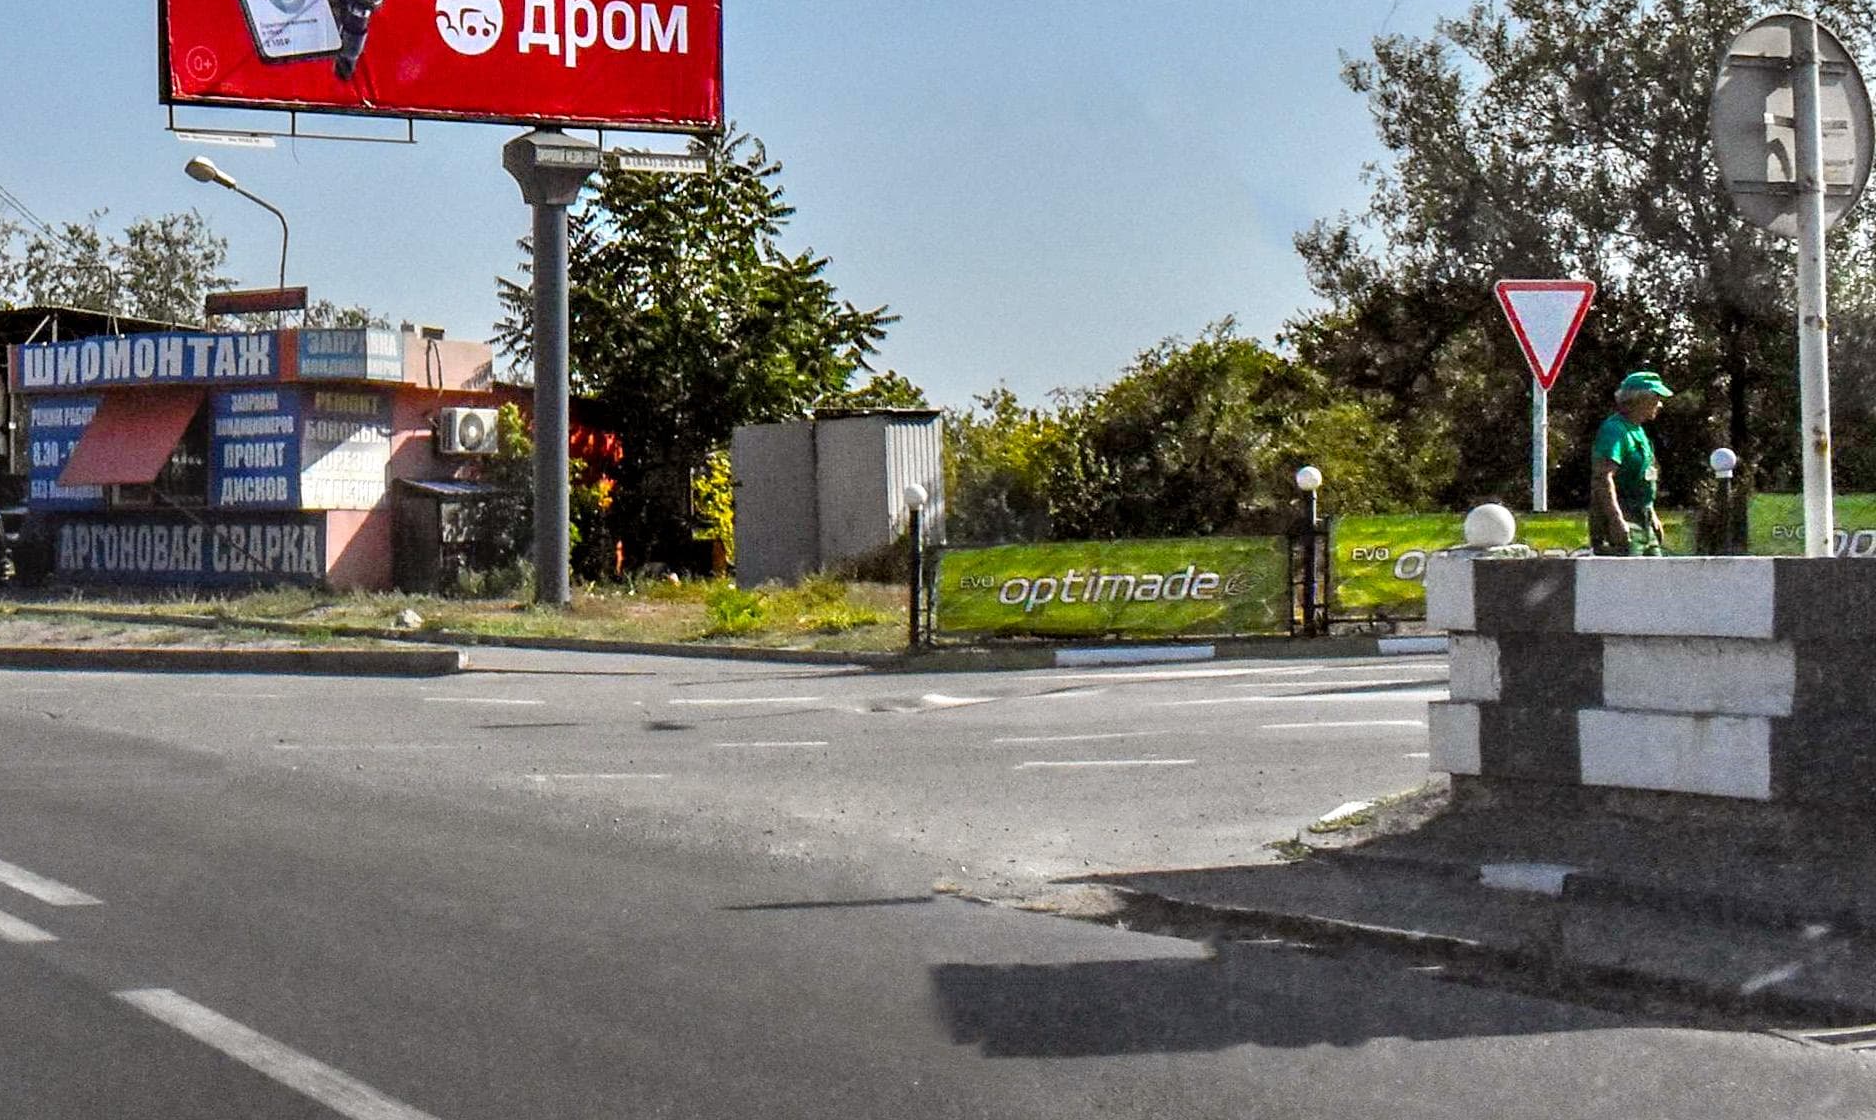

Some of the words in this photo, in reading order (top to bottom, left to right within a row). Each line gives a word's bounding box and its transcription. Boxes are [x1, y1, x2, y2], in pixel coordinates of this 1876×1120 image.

[194, 55, 213, 71] 0+
[24, 335, 271, 386] ШИОМОНТАЖ
[224, 442, 285, 468] ПРОКАТ
[221, 476, 287, 505] ДИСКОВ
[59, 524, 202, 571] АРГОНОВАЯ
[212, 525, 321, 578] СВАРКА
[1352, 548, 1389, 562] EVO
[960, 576, 995, 589] EVO
[999, 564, 1220, 612] optimade
